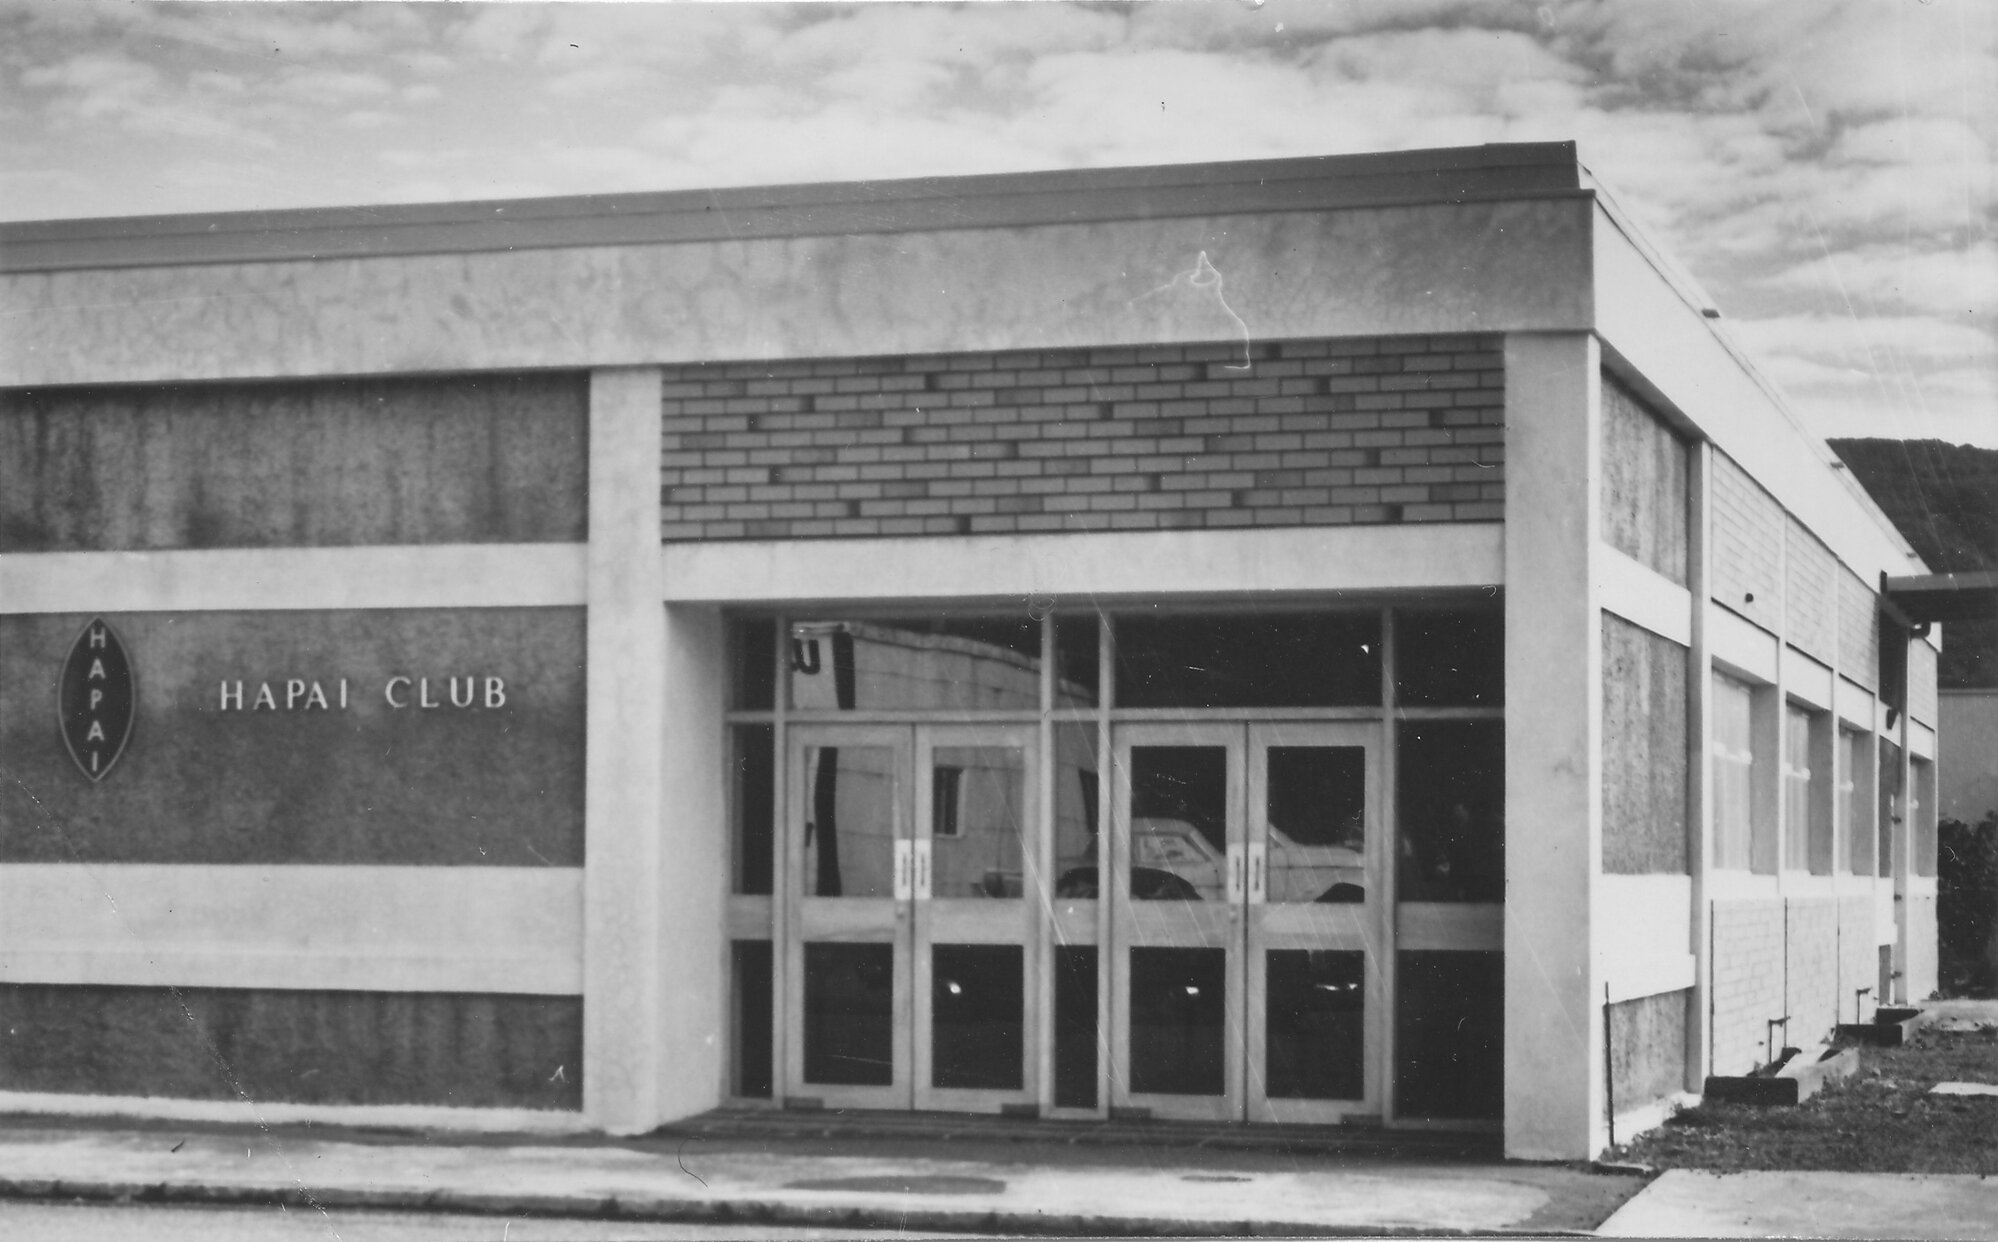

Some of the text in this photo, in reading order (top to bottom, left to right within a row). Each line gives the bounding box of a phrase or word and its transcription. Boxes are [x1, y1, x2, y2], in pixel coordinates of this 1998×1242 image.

[87, 627, 106, 772] HAPAI
[220, 676, 506, 710] HAPAI CLUB
